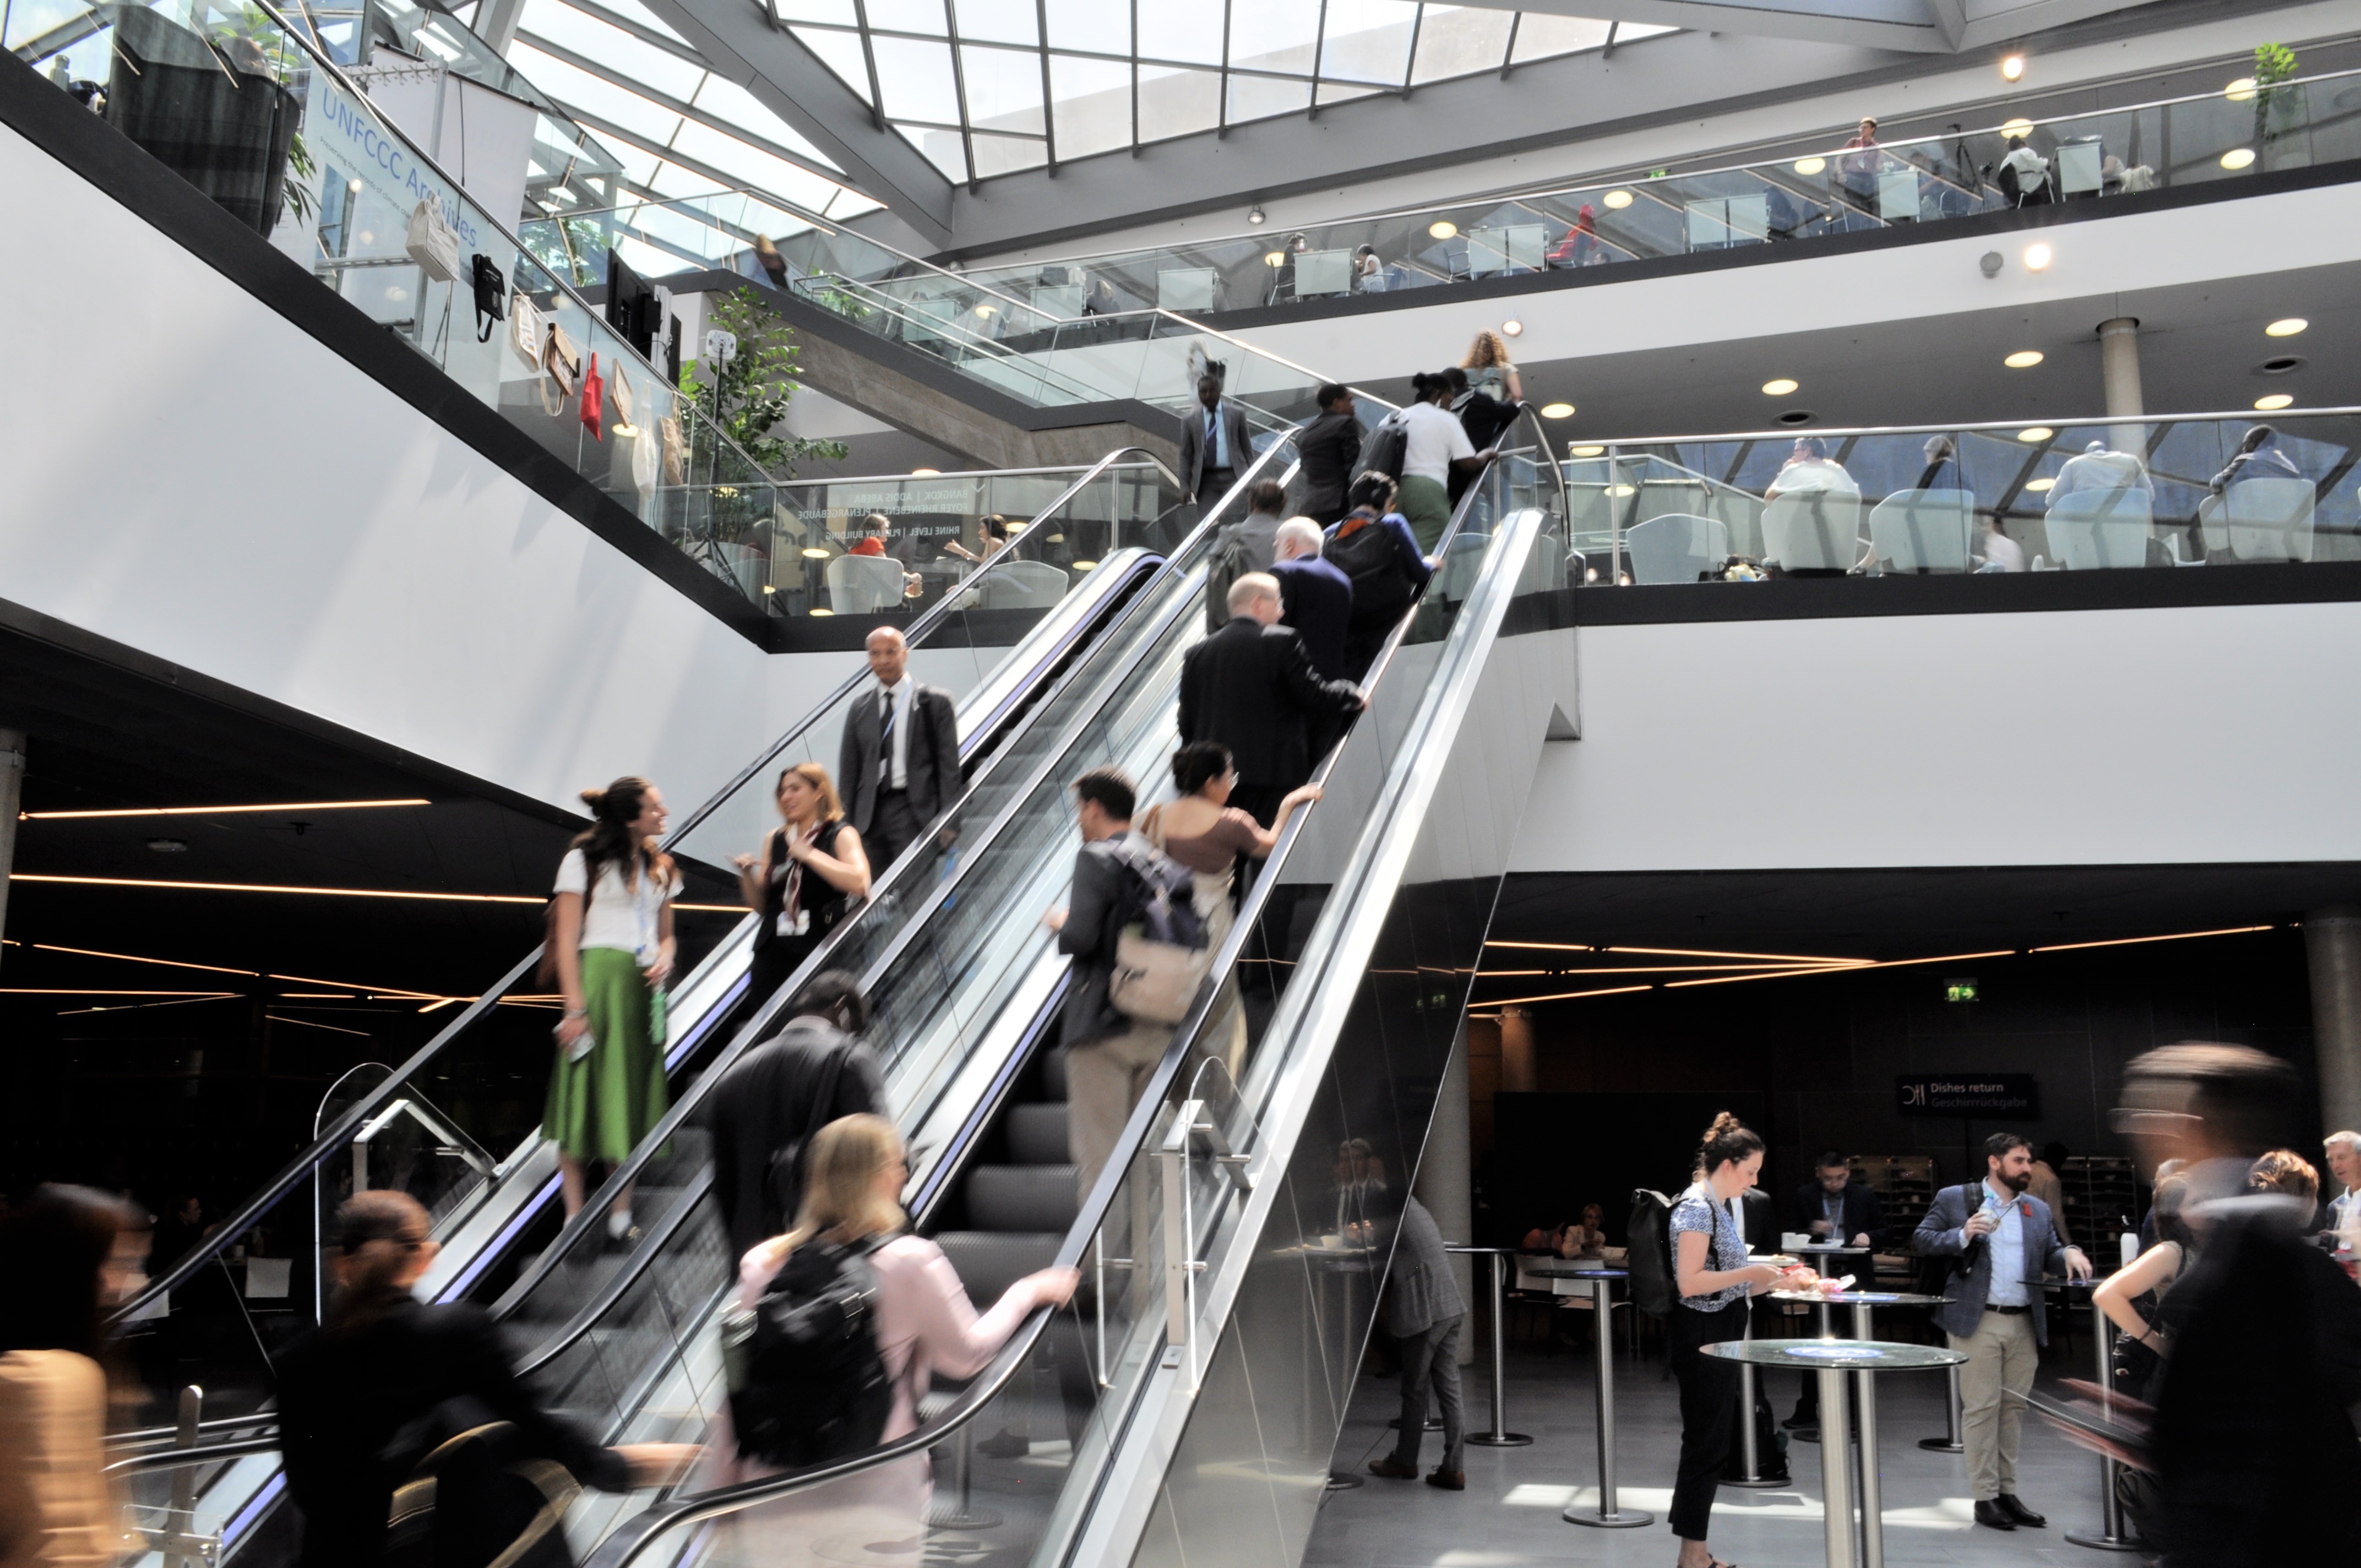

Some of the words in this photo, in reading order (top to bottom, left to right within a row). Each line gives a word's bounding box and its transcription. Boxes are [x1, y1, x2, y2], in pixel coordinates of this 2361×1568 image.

[323, 88, 402, 180] UNFCCC
[320, 136, 347, 167] Preserving
[347, 161, 357, 173] the
[358, 170, 376, 190] records
[383, 193, 401, 211] climate
[1930, 1082, 1966, 1093] Dishes
[1968, 1084, 2004, 1093] return
[1931, 1097, 2027, 1109] Geschirrrückgabe
